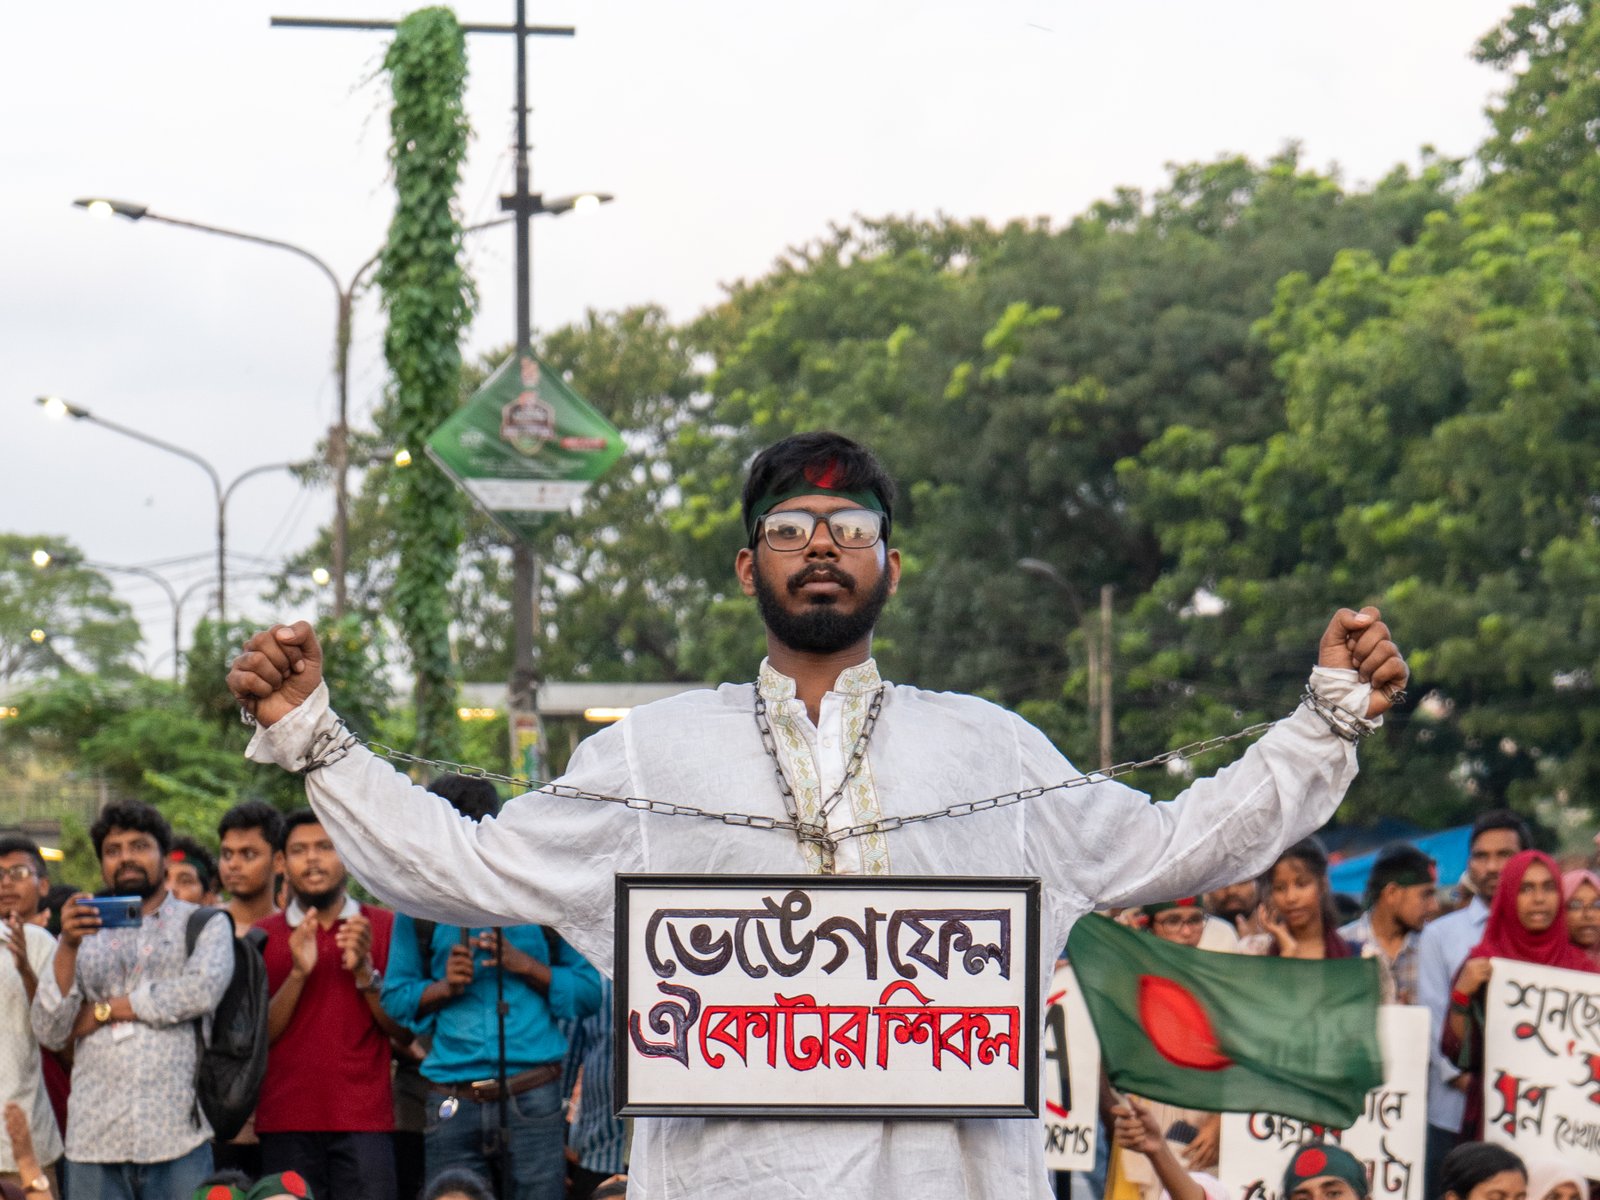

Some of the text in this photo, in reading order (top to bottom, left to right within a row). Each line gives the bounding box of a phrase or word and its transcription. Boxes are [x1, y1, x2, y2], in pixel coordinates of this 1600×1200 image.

[888, 908, 1011, 980] ফেল
[629, 980, 1021, 1071] ঐ কোটার শিকল
